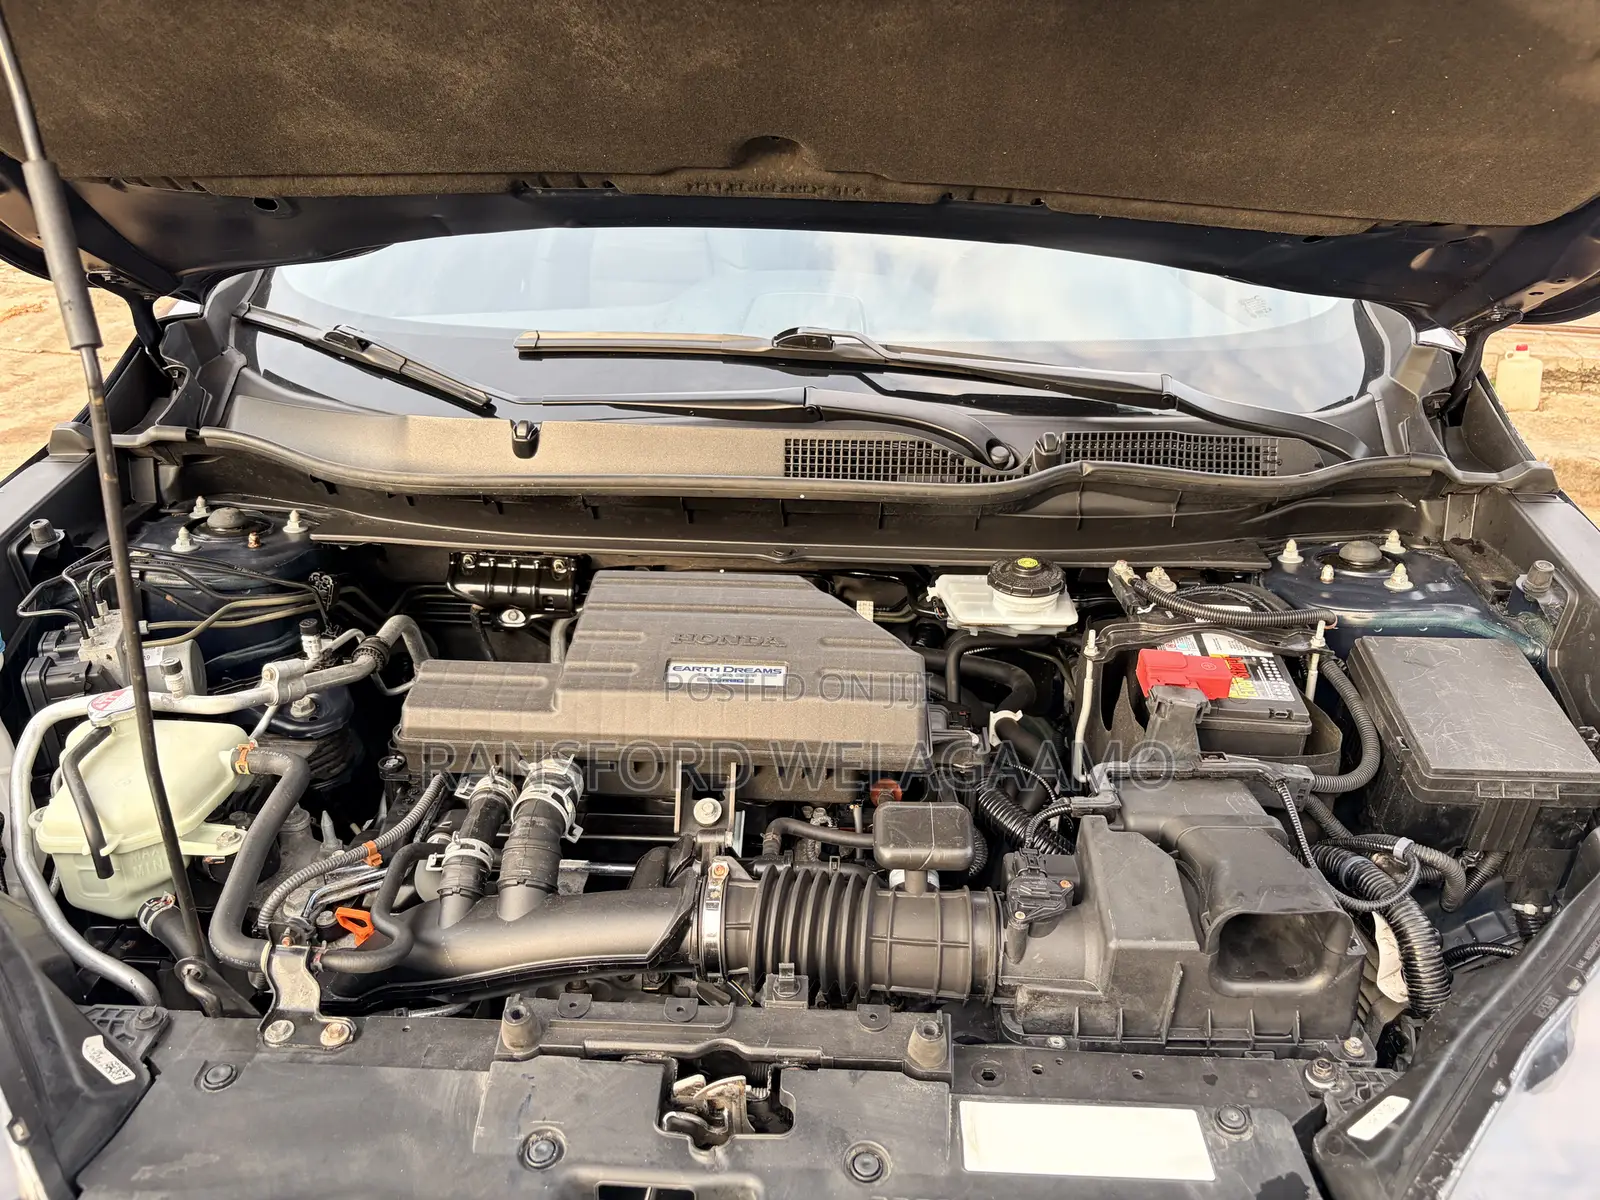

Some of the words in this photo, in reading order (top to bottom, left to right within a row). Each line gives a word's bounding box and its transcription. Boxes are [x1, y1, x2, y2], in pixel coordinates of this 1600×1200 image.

[670, 633, 787, 648] HONDA
[672, 665, 720, 673] EARTH
[723, 666, 782, 675] DREAMS
[132, 857, 164, 879] MIN
